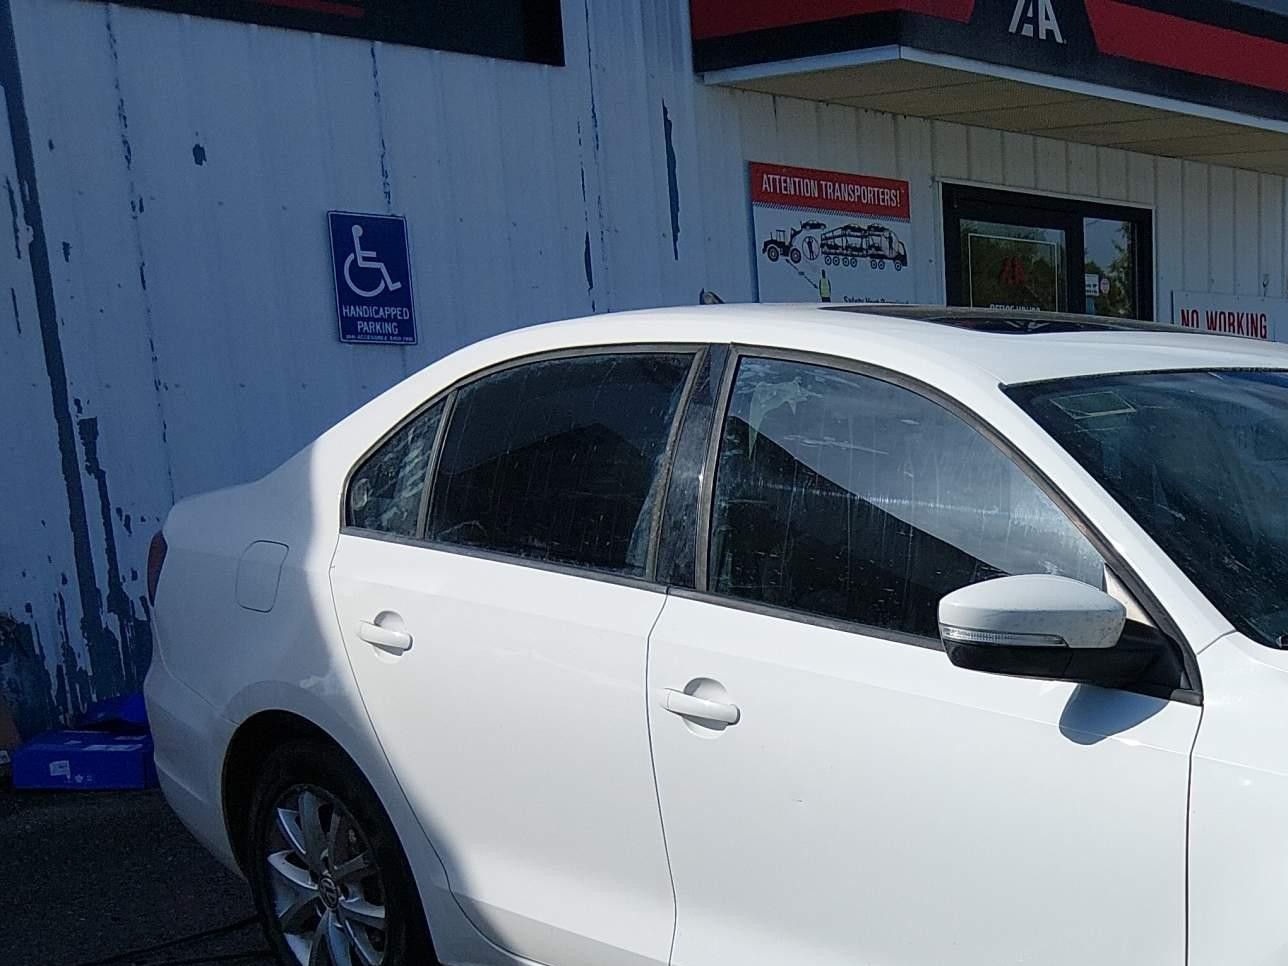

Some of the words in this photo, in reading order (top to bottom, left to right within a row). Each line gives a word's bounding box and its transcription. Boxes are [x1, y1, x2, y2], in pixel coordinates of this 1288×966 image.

[762, 173, 818, 198] ATTENTION
[820, 181, 901, 207] TRANSPORTERS!
[343, 305, 409, 319] HANDICAPPED
[357, 321, 398, 334] PARKING
[1181, 309, 1199, 328] NO
[1206, 311, 1267, 338] WORKING
